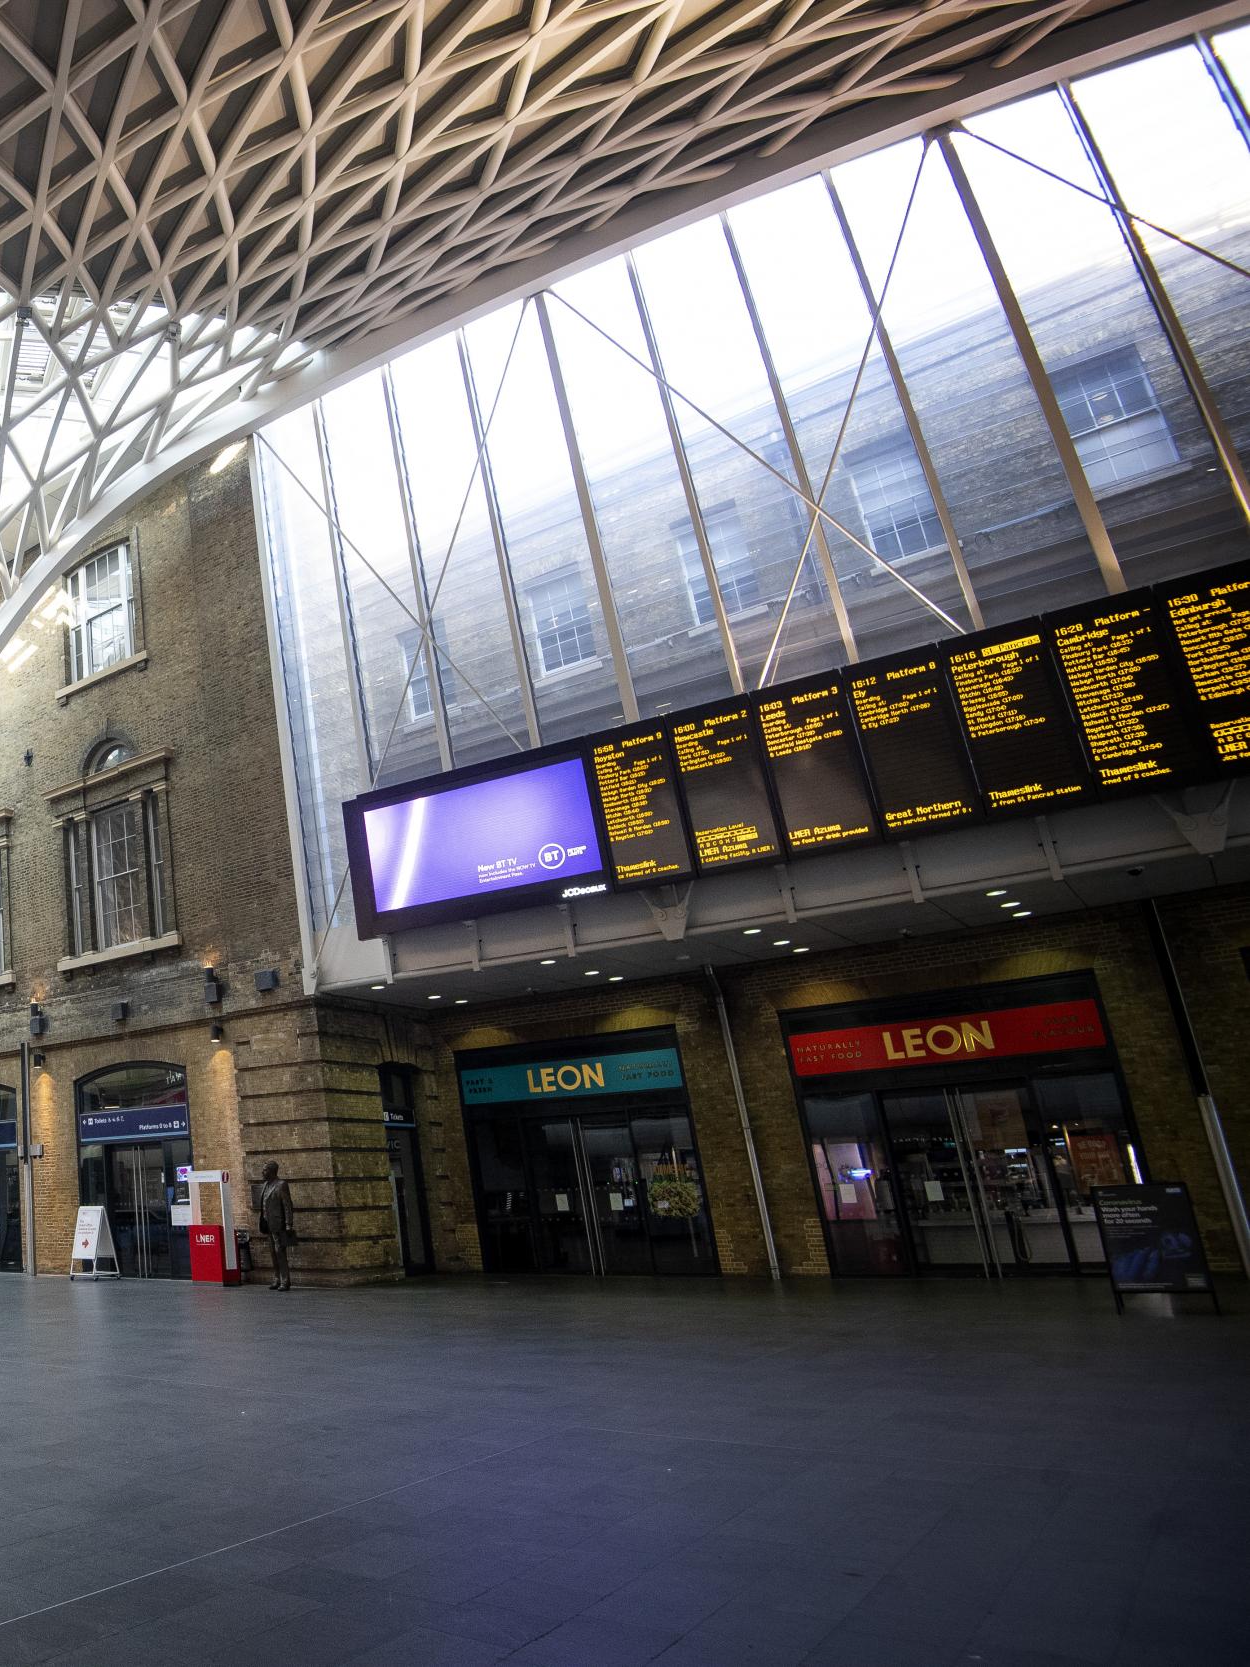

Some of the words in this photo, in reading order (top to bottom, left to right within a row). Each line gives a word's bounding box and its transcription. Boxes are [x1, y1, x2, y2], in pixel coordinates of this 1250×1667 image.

[1170, 599, 1226, 618] Edinburgh
[1094, 610, 1140, 626] Platform
[1176, 623, 1200, 632] Calling
[1178, 623, 1228, 639] Peterborough
[1057, 629, 1109, 647] Cambridge
[1060, 645, 1082, 654] Calling
[1062, 649, 1091, 660] Finsbury
[950, 651, 976, 664] 16:16
[951, 651, 1019, 674] Peterborough
[1064, 654, 1091, 667] Potters
[1066, 663, 1094, 673] Hatfield
[1093, 665, 1118, 674] Garden
[1119, 661, 1135, 670] City
[852, 677, 876, 689] 16:12
[886, 666, 926, 680] Platform
[984, 672, 999, 680] Park
[1096, 672, 1116, 681] North
[791, 690, 828, 704] Platform
[853, 690, 866, 699] Ely
[1208, 687, 1245, 699] Edinburgh
[1077, 698, 1100, 707] Hitchin
[760, 710, 786, 722] Leeds
[858, 707, 888, 717] Cambridge
[860, 712, 889, 724] Cambridge
[1081, 710, 1107, 720] Baldock
[1118, 710, 1144, 719] Morden
[704, 714, 738, 727] Platform
[978, 722, 1022, 736] Peterborough
[1085, 724, 1114, 734] Royston
[622, 735, 654, 748] Platform
[674, 729, 714, 743] Newcastle
[1102, 749, 1137, 759] Cambridge
[1218, 741, 1248, 754] LNER
[594, 752, 624, 763] Royston
[1099, 760, 1157, 778] Thameslink
[988, 783, 1042, 800] Thameslink
[1027, 791, 1054, 800] Pancras
[885, 809, 913, 821] Great
[916, 801, 961, 815] Northern
[788, 828, 811, 840] LNER
[813, 824, 842, 835] Azuma
[699, 846, 720, 857] LNER
[722, 839, 748, 853] Azuma
[544, 850, 559, 862] BT
[478, 862, 494, 872] New
[496, 859, 505, 868] BT
[508, 858, 517, 866] TV
[616, 859, 657, 873] Thameslink
[562, 884, 606, 898] JCDecaux
[882, 1020, 996, 1060] LEON
[796, 1040, 861, 1054] NATURALLY
[799, 1054, 825, 1064] FAST
[831, 1051, 863, 1061] FOOD
[527, 1063, 605, 1093] LEON
[647, 1069, 675, 1078] FOOD
[196, 1234, 215, 1243] LNER
